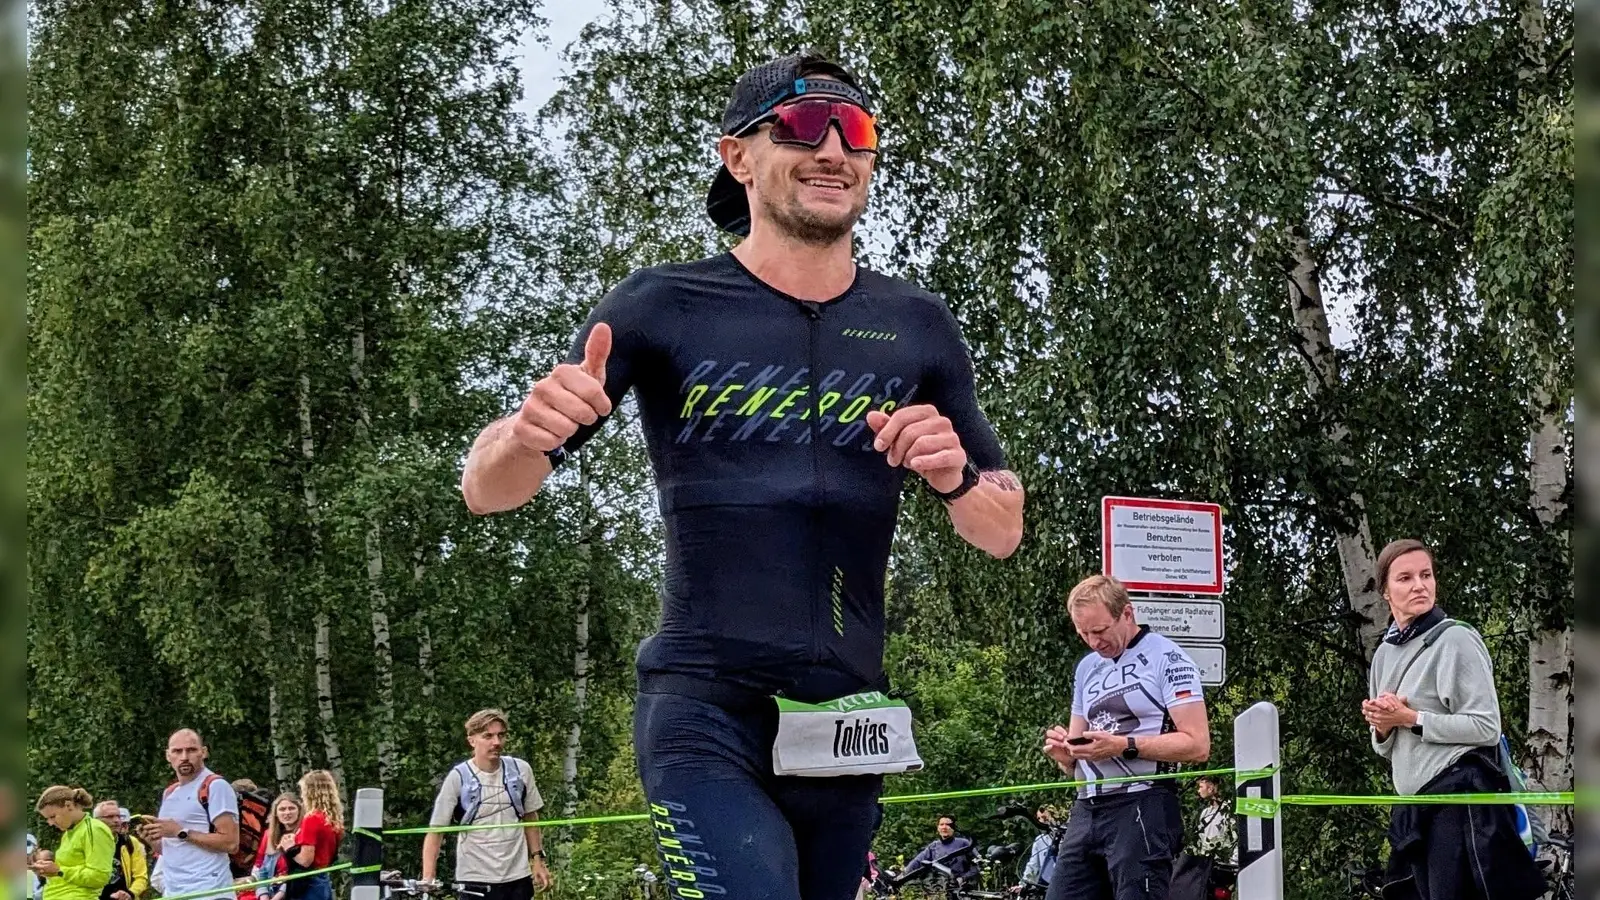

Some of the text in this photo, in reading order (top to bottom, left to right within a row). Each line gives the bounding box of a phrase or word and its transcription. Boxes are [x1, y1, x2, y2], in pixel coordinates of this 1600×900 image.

[1132, 511, 1194, 524] Betriebsgelände
[1146, 532, 1182, 543] Benutzen
[1147, 553, 1182, 562] verboten
[1137, 606, 1214, 616] Fußgänger und Radfahrer
[1087, 664, 1140, 703] SCR
[833, 718, 889, 758] Tobias
